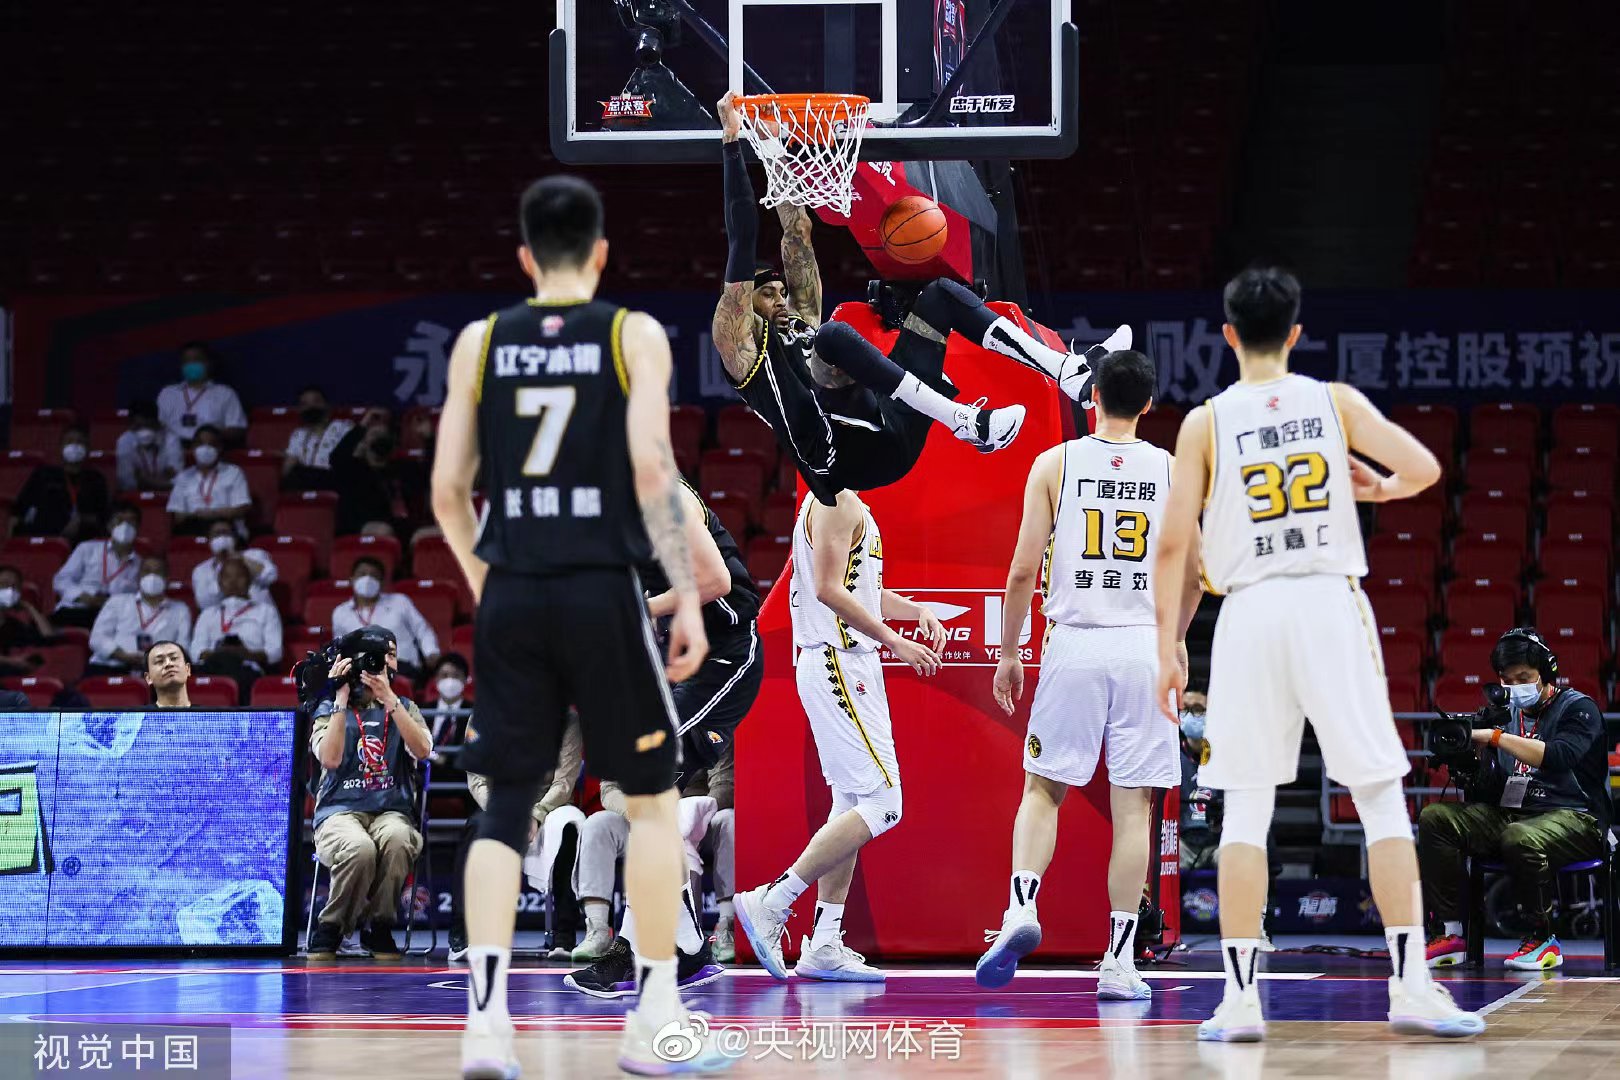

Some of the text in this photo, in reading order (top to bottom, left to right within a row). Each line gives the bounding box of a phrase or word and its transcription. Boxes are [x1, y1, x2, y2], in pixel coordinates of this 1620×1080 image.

[608, 101, 644, 111] 总决赛
[951, 97, 1014, 111] 忠于所爱
[515, 385, 576, 476] 7
[1236, 417, 1324, 456] 广厦控股
[1077, 479, 1156, 502] 广厦控股
[1240, 452, 1330, 523] 32
[1081, 508, 1150, 563] 13
[1074, 570, 1148, 591] 李金效
[984, 647, 1033, 661] YERS
